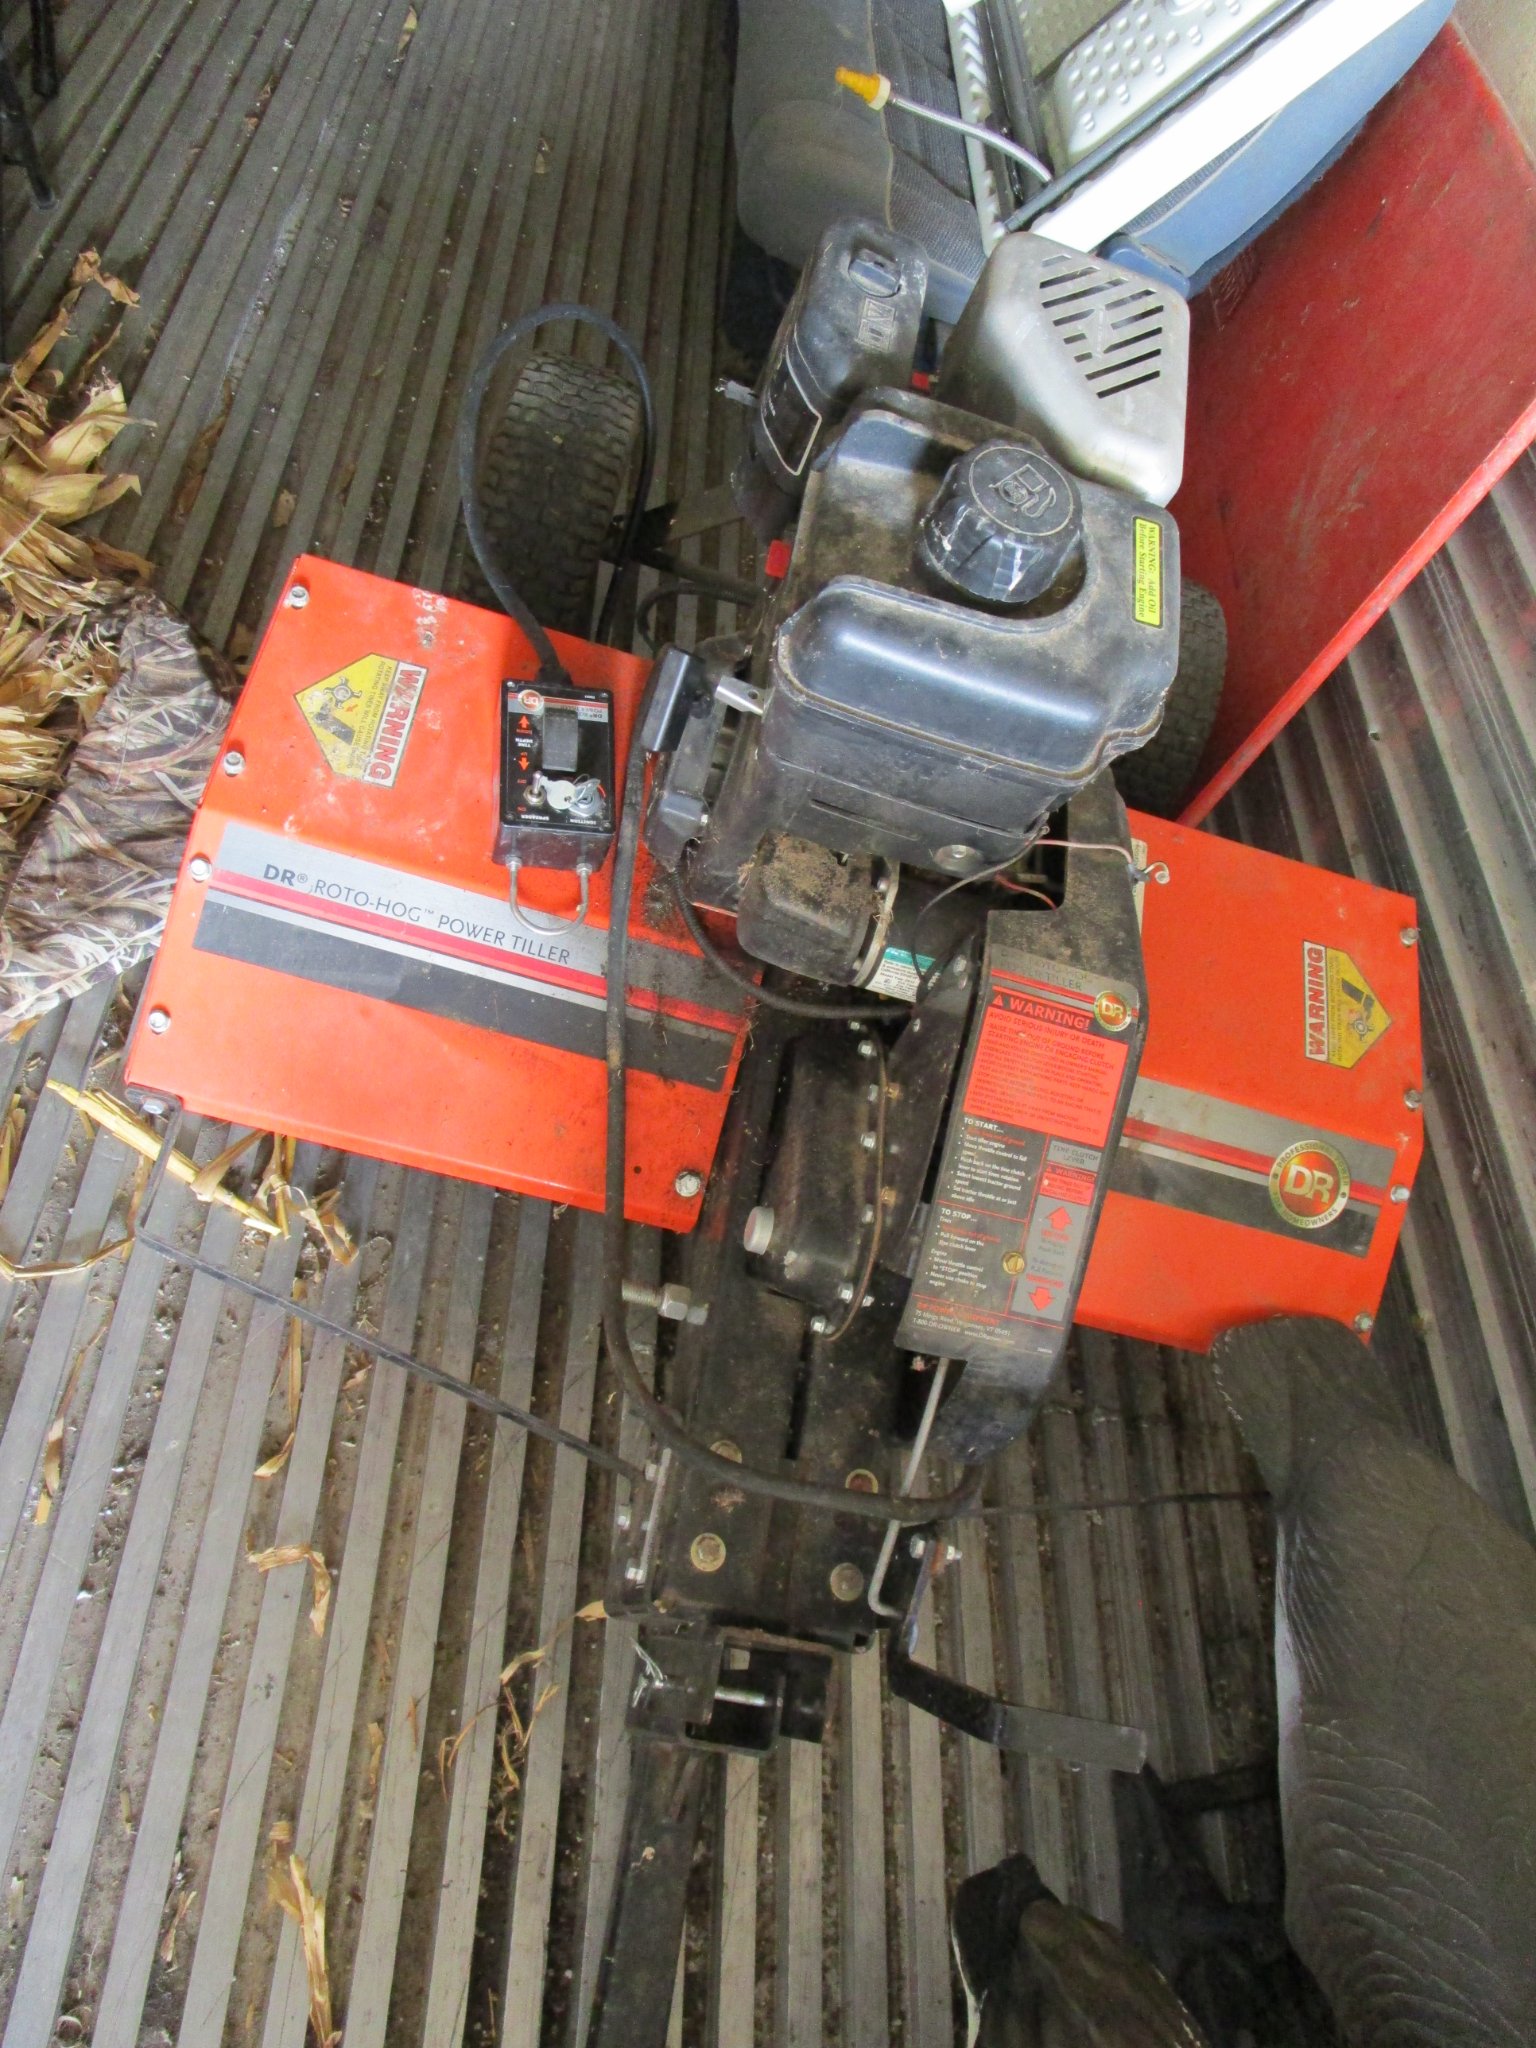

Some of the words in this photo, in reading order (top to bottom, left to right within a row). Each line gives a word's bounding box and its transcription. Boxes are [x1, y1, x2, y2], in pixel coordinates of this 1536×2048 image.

[1138, 523, 1146, 549] Before
[1136, 552, 1146, 584] Starting
[1148, 578, 1156, 597] Add
[1138, 588, 1146, 617] Engine
[1148, 599, 1156, 614] Oil
[367, 669, 422, 780] WARNING
[438, 914, 506, 946] POWER
[512, 934, 570, 964] TILLER
[1102, 1000, 1124, 1018] DR
[1307, 947, 1325, 1055] WARNING
[1009, 997, 1090, 1030] WARNING!
[989, 1012, 1011, 1022] AVOID
[1012, 1018, 1042, 1031] SERIOUS
[1044, 1026, 1067, 1038] INJURY
[1081, 1037, 1105, 1048] DEATH
[988, 1141, 1005, 1149] engine
[995, 1149, 1012, 1158] control
[1071, 1148, 1098, 1161] CLUTCH
[956, 1170, 971, 1178] Select
[1003, 1182, 1021, 1191] ground
[1010, 1168, 1025, 1176] clutch
[1284, 1164, 1334, 1204] DR
[930, 1248, 947, 1257] Engine
[928, 1279, 946, 1287] engine
[957, 1270, 978, 1279] position
